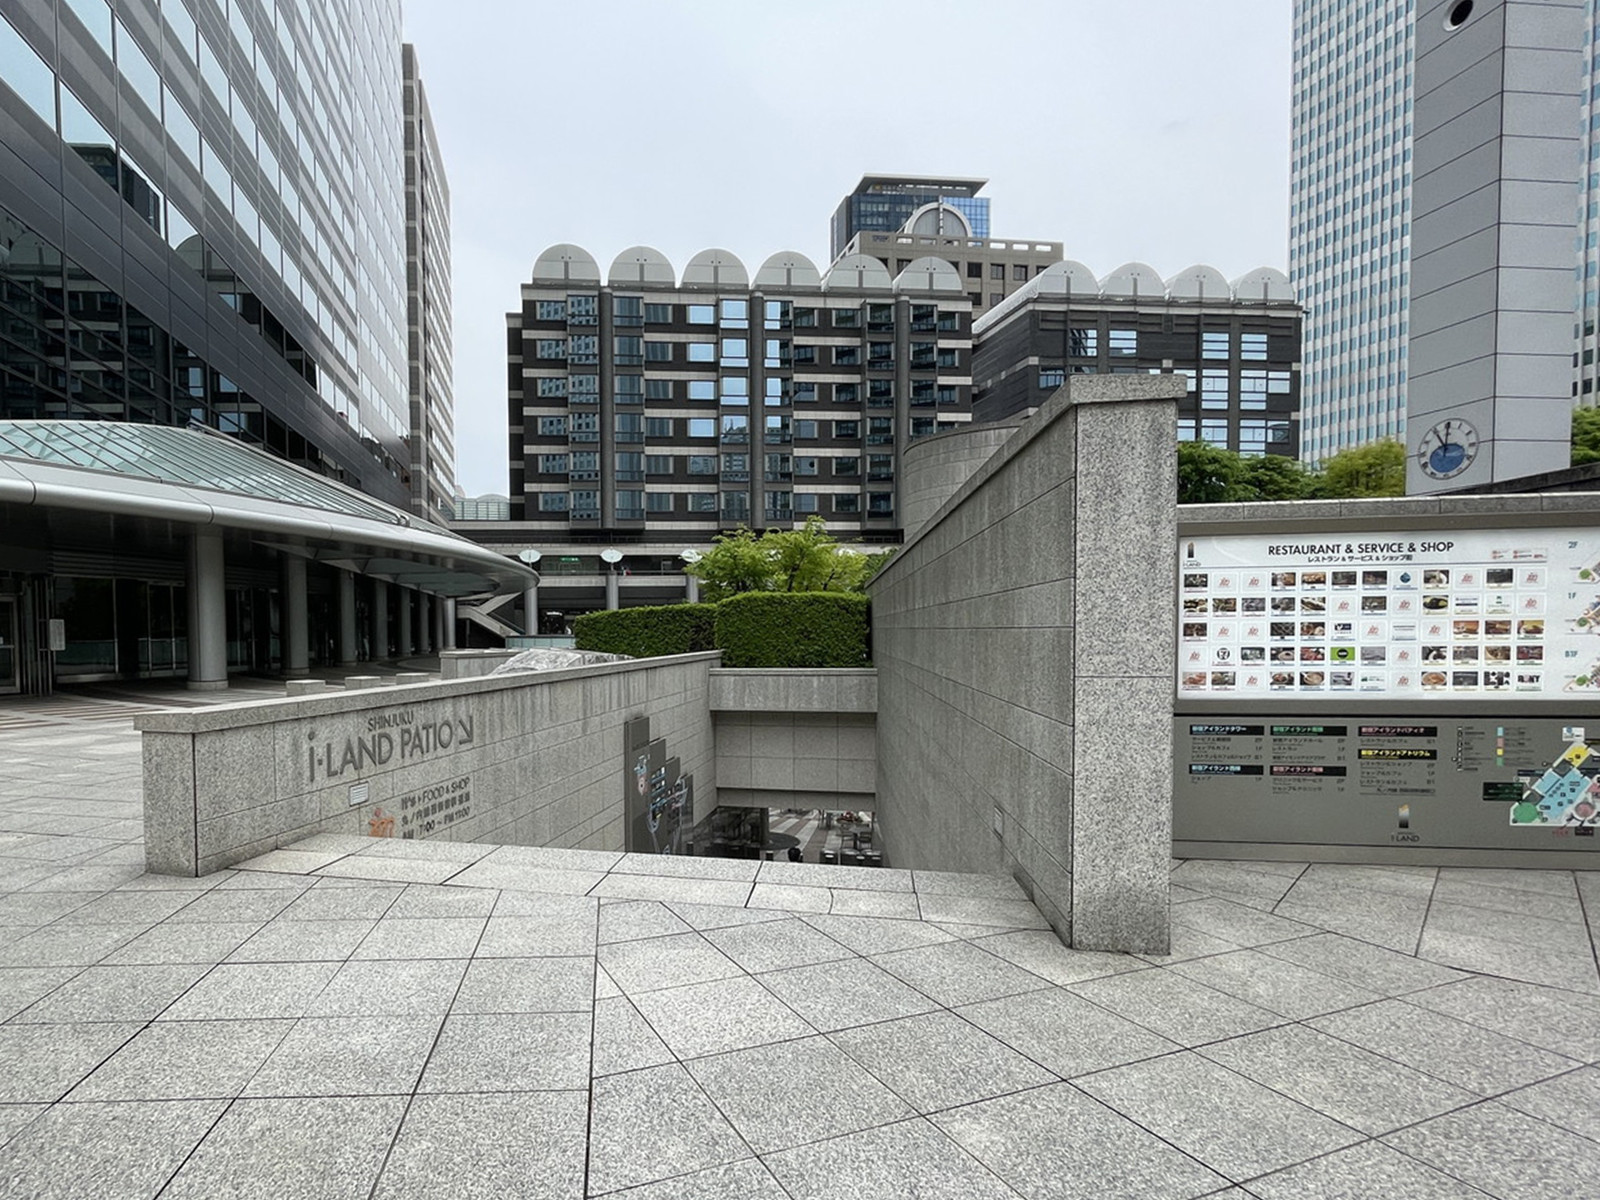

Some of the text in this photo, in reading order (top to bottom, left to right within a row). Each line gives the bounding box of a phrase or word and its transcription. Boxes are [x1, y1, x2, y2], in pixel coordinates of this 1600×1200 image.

[1268, 541, 1454, 556] RESTAURANT & SERVICE & SHOP
[367, 711, 414, 732] SHINJUKU
[401, 719, 453, 759] PATIO
[422, 785, 445, 803] FOOD
[451, 776, 470, 794] SHOP
